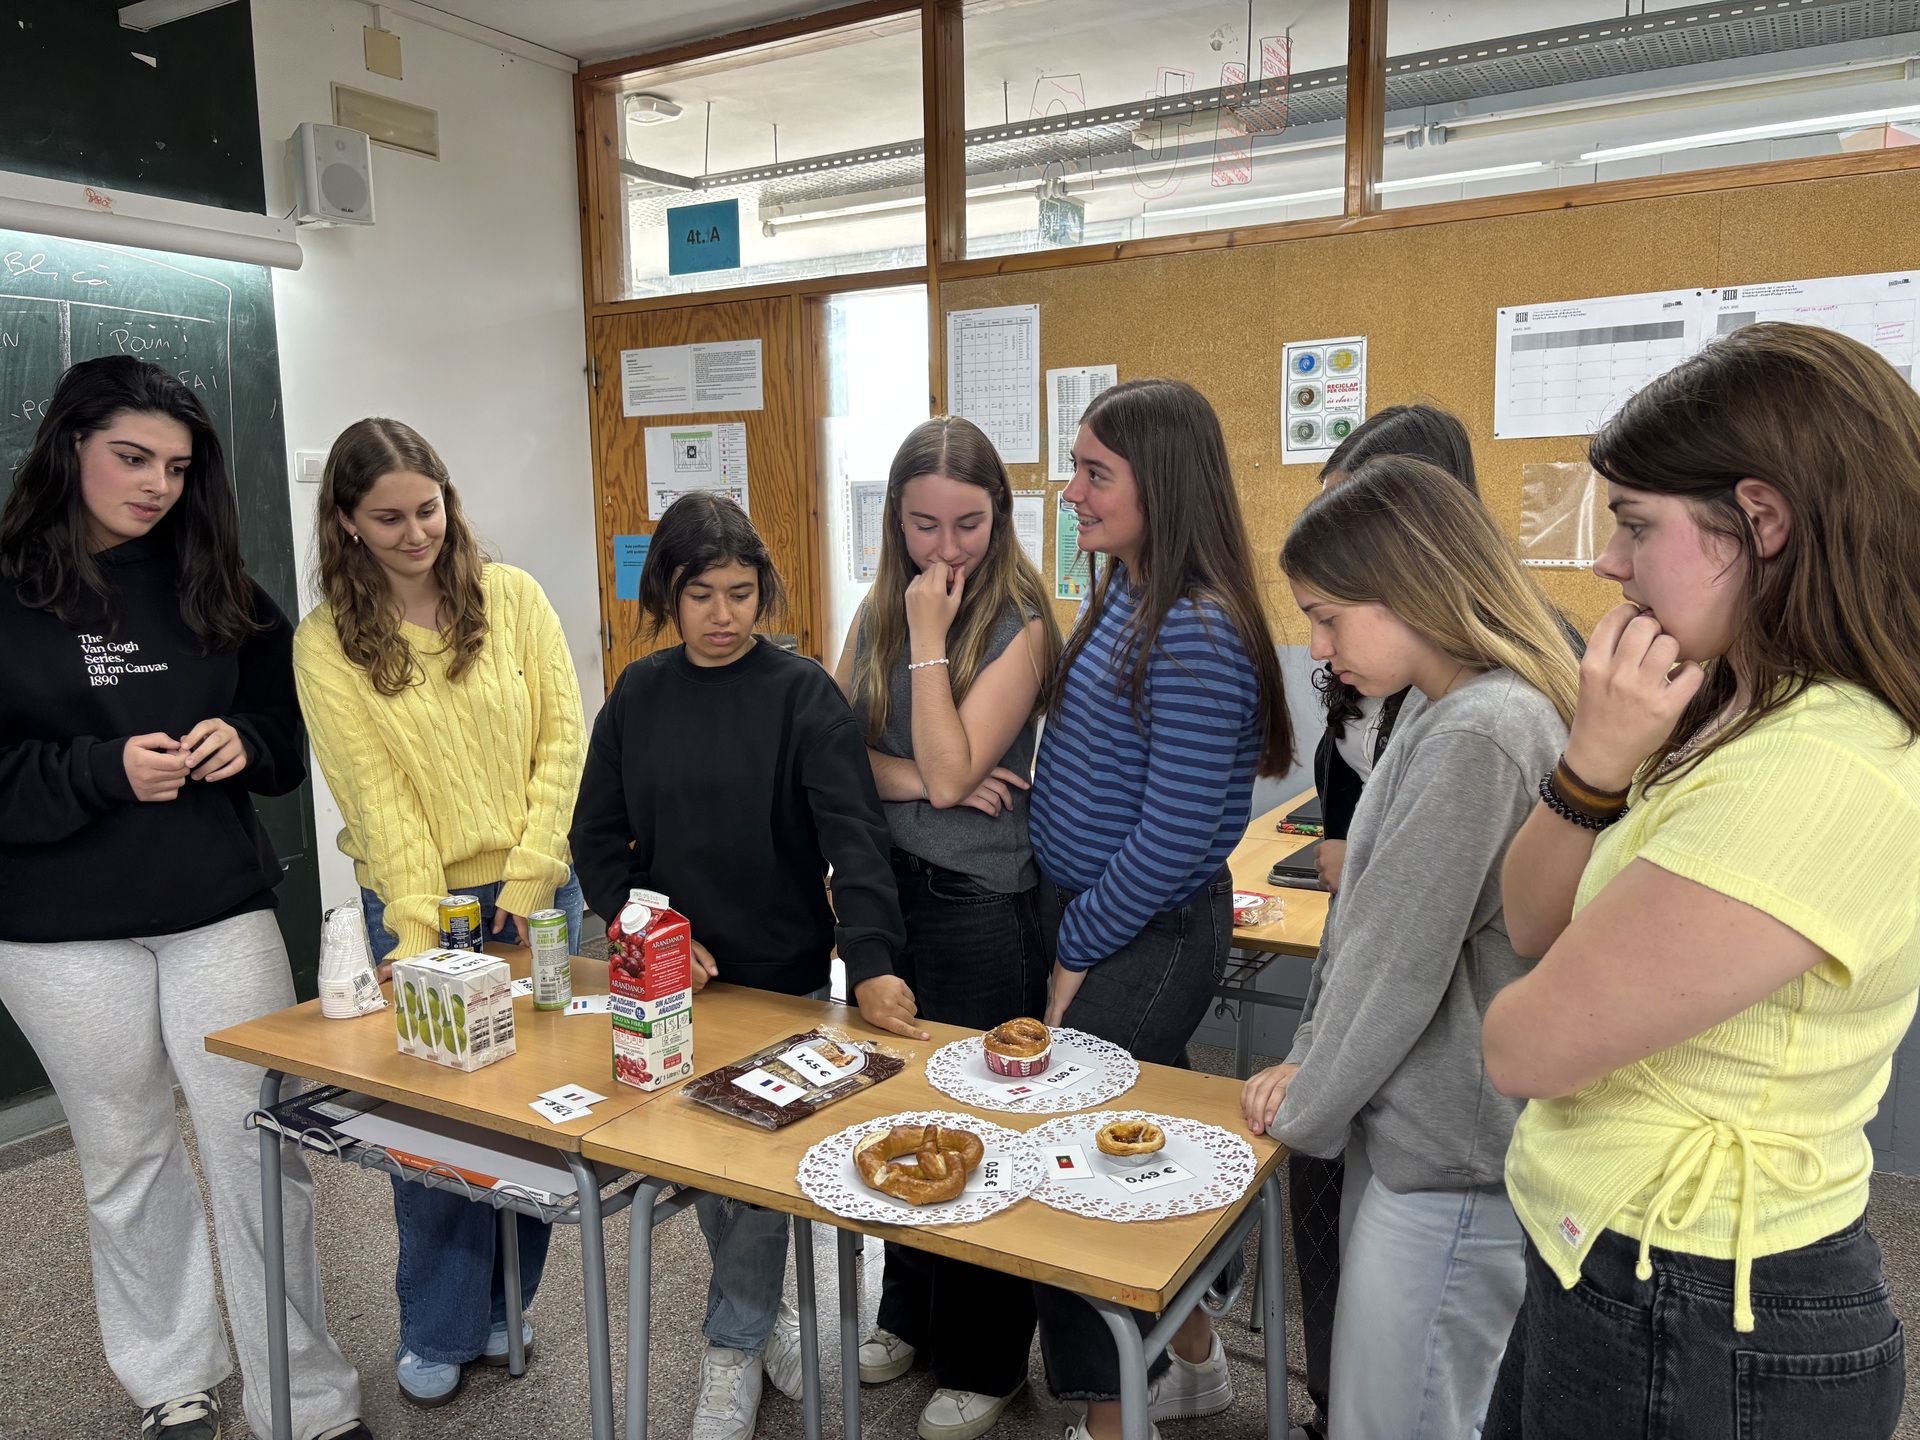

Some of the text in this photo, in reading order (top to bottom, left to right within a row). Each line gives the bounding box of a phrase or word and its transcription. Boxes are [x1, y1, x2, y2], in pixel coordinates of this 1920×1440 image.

[687, 226, 720, 245] 4t. A
[78, 634, 103, 644] The
[81, 641, 139, 654] Van Gogh
[84, 653, 125, 664] Series.
[88, 662, 169, 675] Oil on Canvas
[90, 675, 118, 686] 1890
[655, 1000, 664, 1008] SIN
[797, 1053, 821, 1069] 1,45
[983, 1161, 998, 1178] 0,55
[1125, 1166, 1177, 1184] 0,49 €
